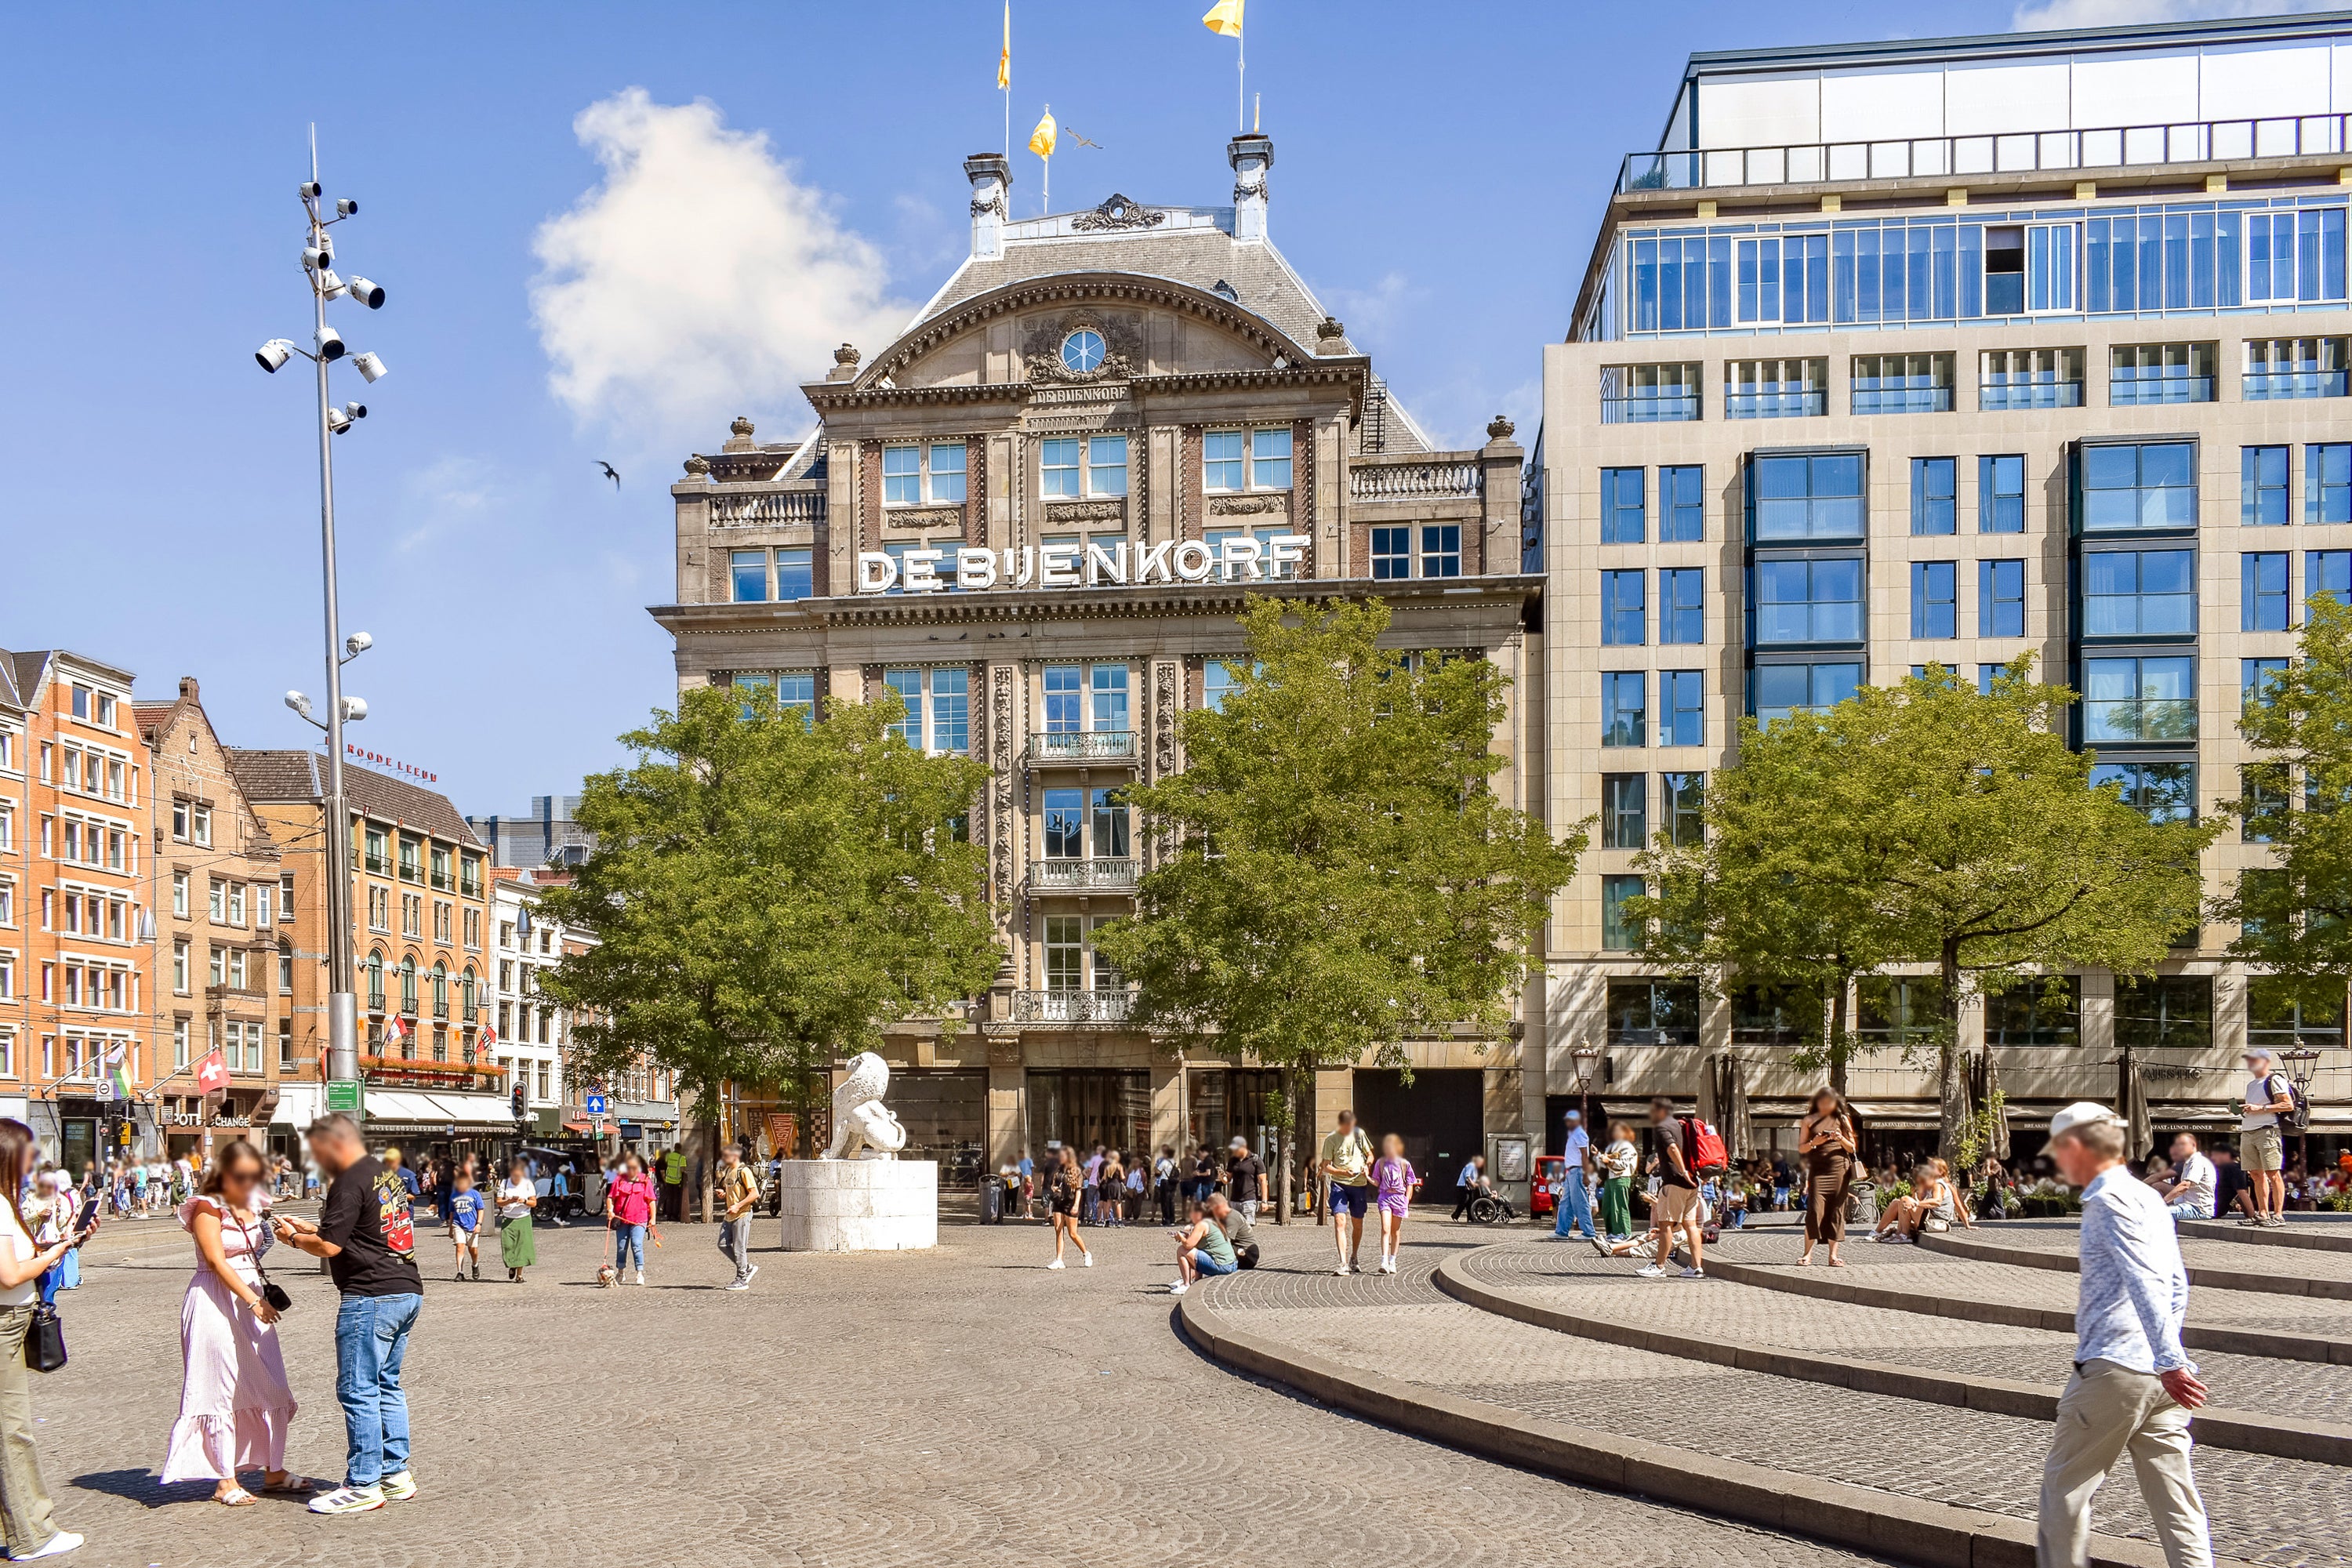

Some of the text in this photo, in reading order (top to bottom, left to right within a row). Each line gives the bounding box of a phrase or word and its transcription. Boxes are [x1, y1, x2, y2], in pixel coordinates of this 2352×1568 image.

[1036, 390, 1057, 404] DE
[858, 535, 1312, 593] DE BIJENKORF
[347, 744, 437, 782] ROODE LEEUW
[2142, 1068, 2202, 1081] AJESTIC
[211, 1117, 250, 1127] CHANGE
